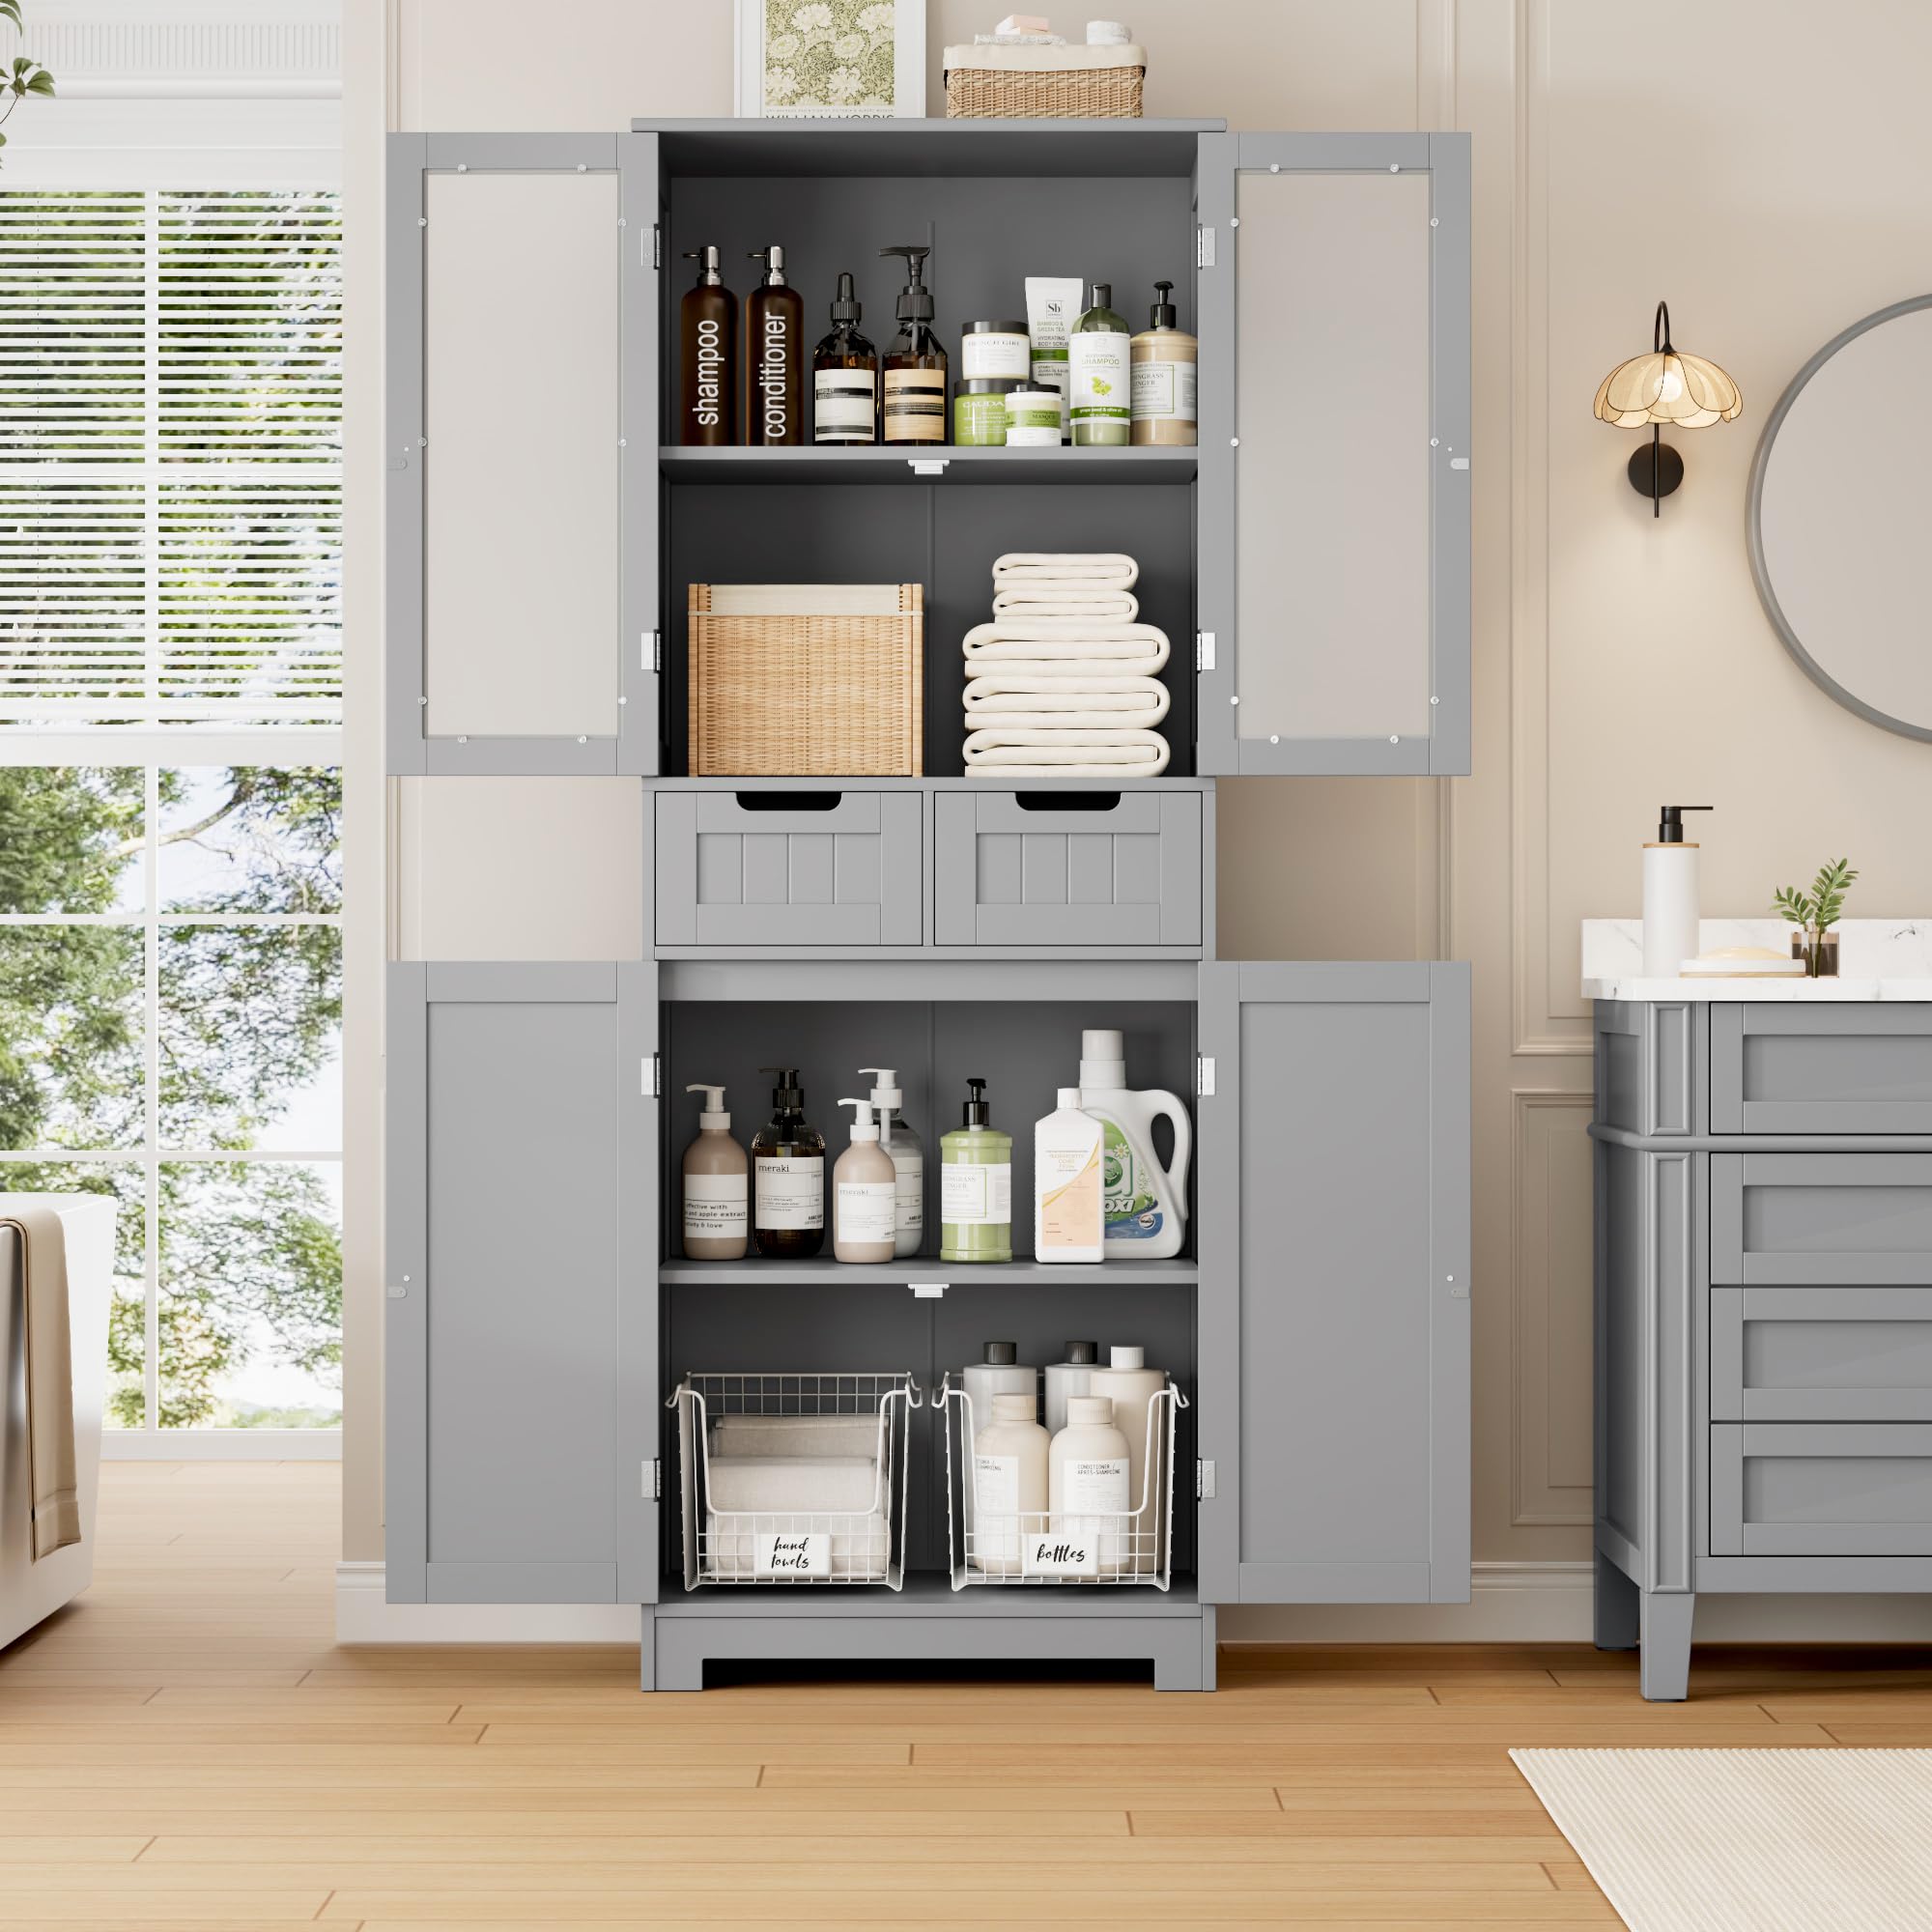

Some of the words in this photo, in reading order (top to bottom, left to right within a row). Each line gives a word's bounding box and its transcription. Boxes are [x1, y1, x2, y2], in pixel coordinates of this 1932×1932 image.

[692, 320, 725, 425] shampoo
[759, 311, 786, 438] conditioner
[758, 1164, 789, 1173] meraki
[1105, 1199, 1135, 1213] OXI
[774, 1536, 810, 1552] hand
[771, 1552, 810, 1569] towels
[1037, 1544, 1085, 1562] bottles
